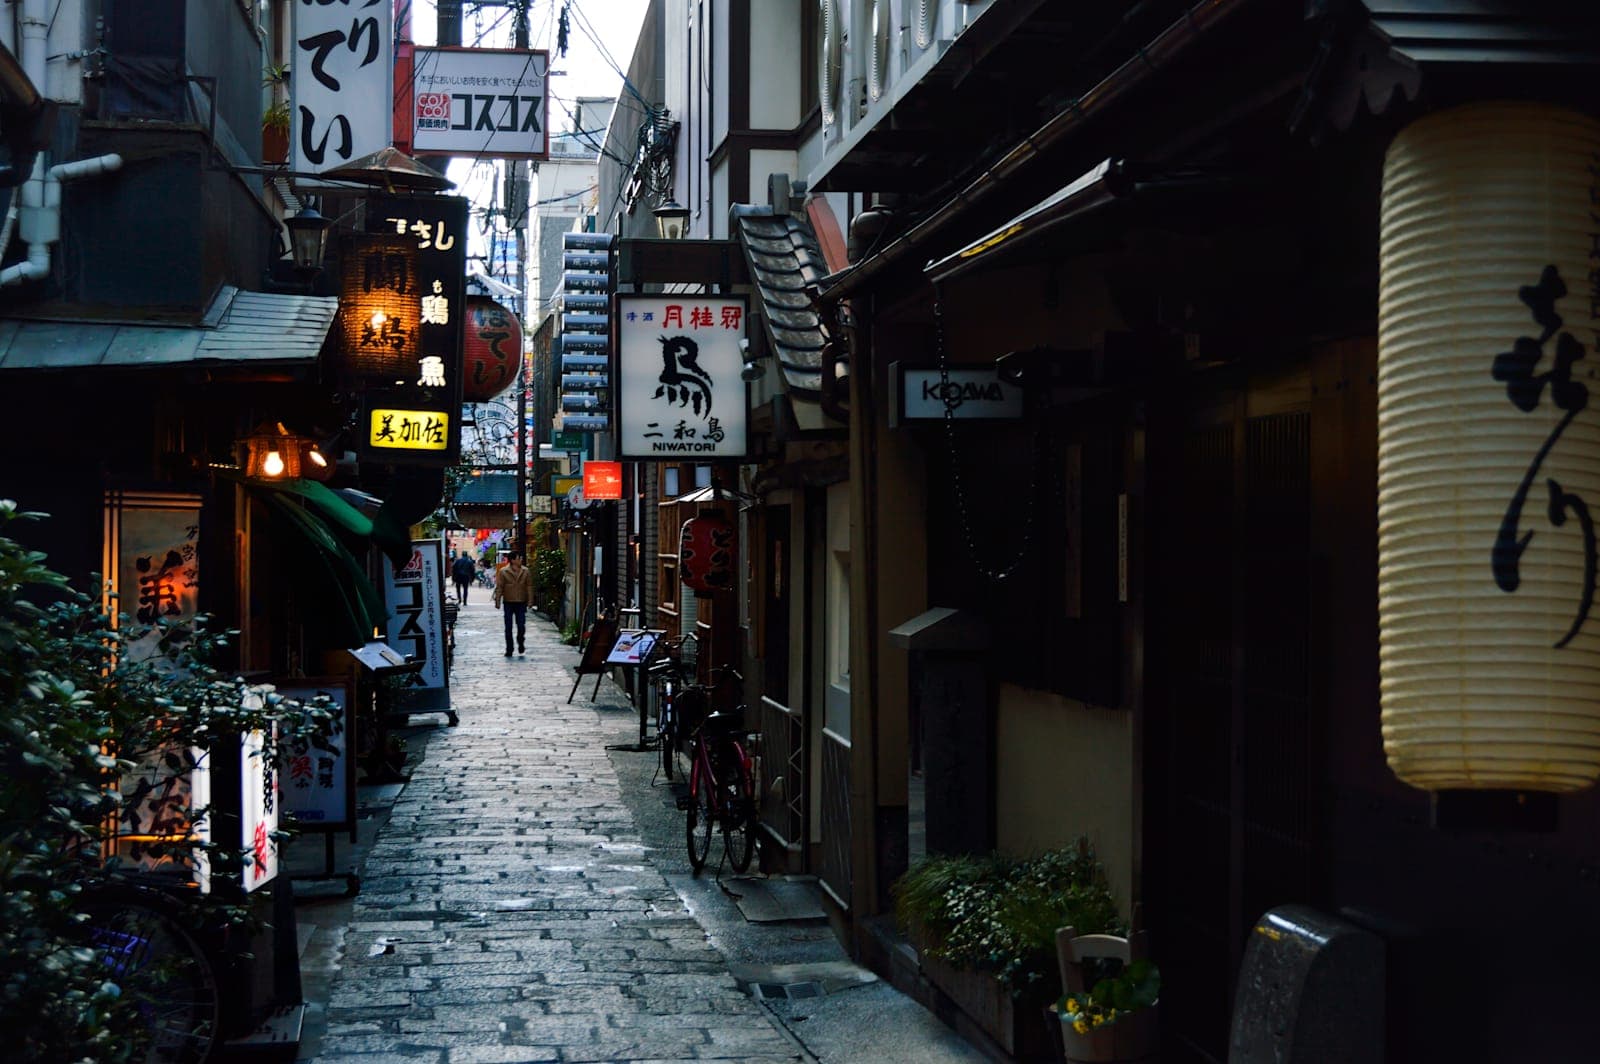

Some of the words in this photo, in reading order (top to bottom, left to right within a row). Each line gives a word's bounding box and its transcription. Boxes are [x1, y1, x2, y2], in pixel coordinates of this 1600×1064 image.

[347, 0, 382, 68] り
[297, 0, 353, 165] てい
[451, 93, 542, 133] コスコス
[385, 217, 456, 253] さし
[662, 304, 742, 330] 月桂冠
[652, 442, 716, 452] NIWATORI
